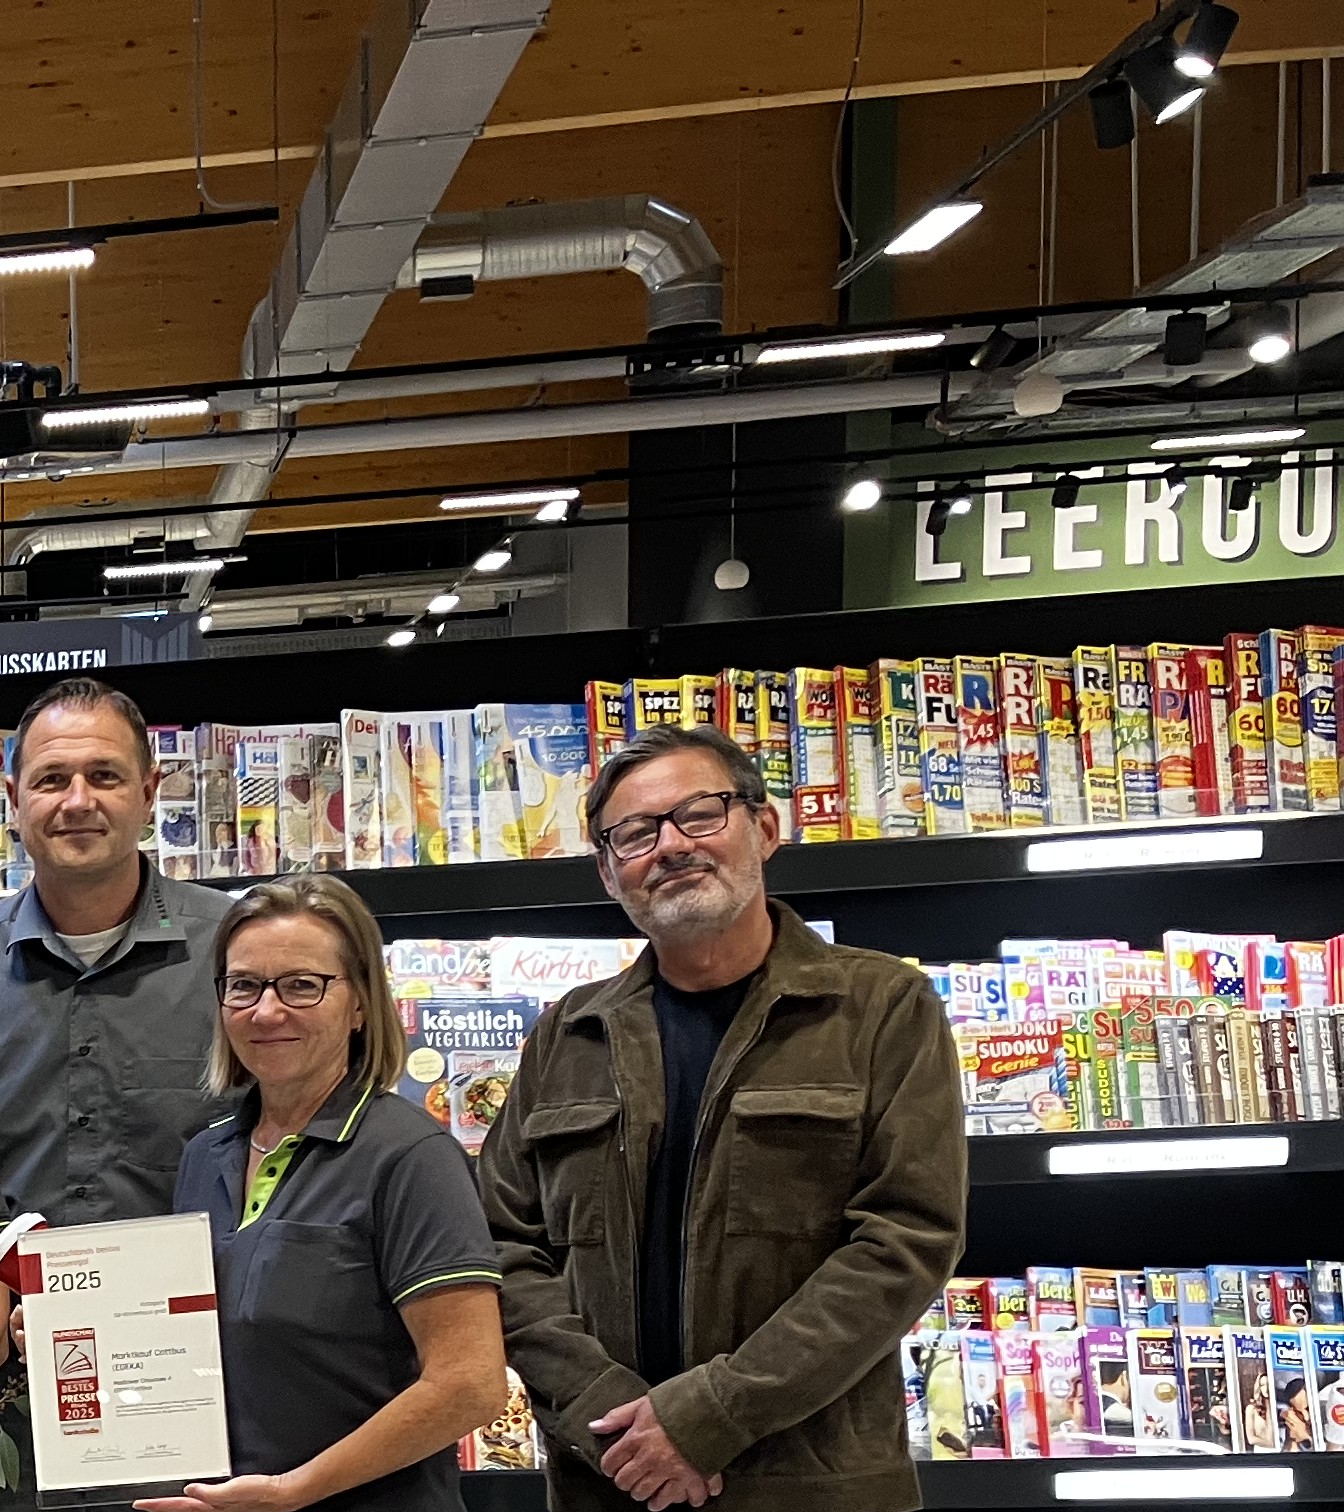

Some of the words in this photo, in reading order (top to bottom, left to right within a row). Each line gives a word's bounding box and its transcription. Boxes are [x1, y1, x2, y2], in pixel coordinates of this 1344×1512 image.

[511, 950, 600, 982] Kürbis
[423, 1010, 524, 1031] köstlich
[979, 1038, 1050, 1060] SUDOKU
[48, 1270, 102, 1293] 2025
[61, 1392, 97, 1404] PRESSE
[65, 1408, 95, 1420] 2025
